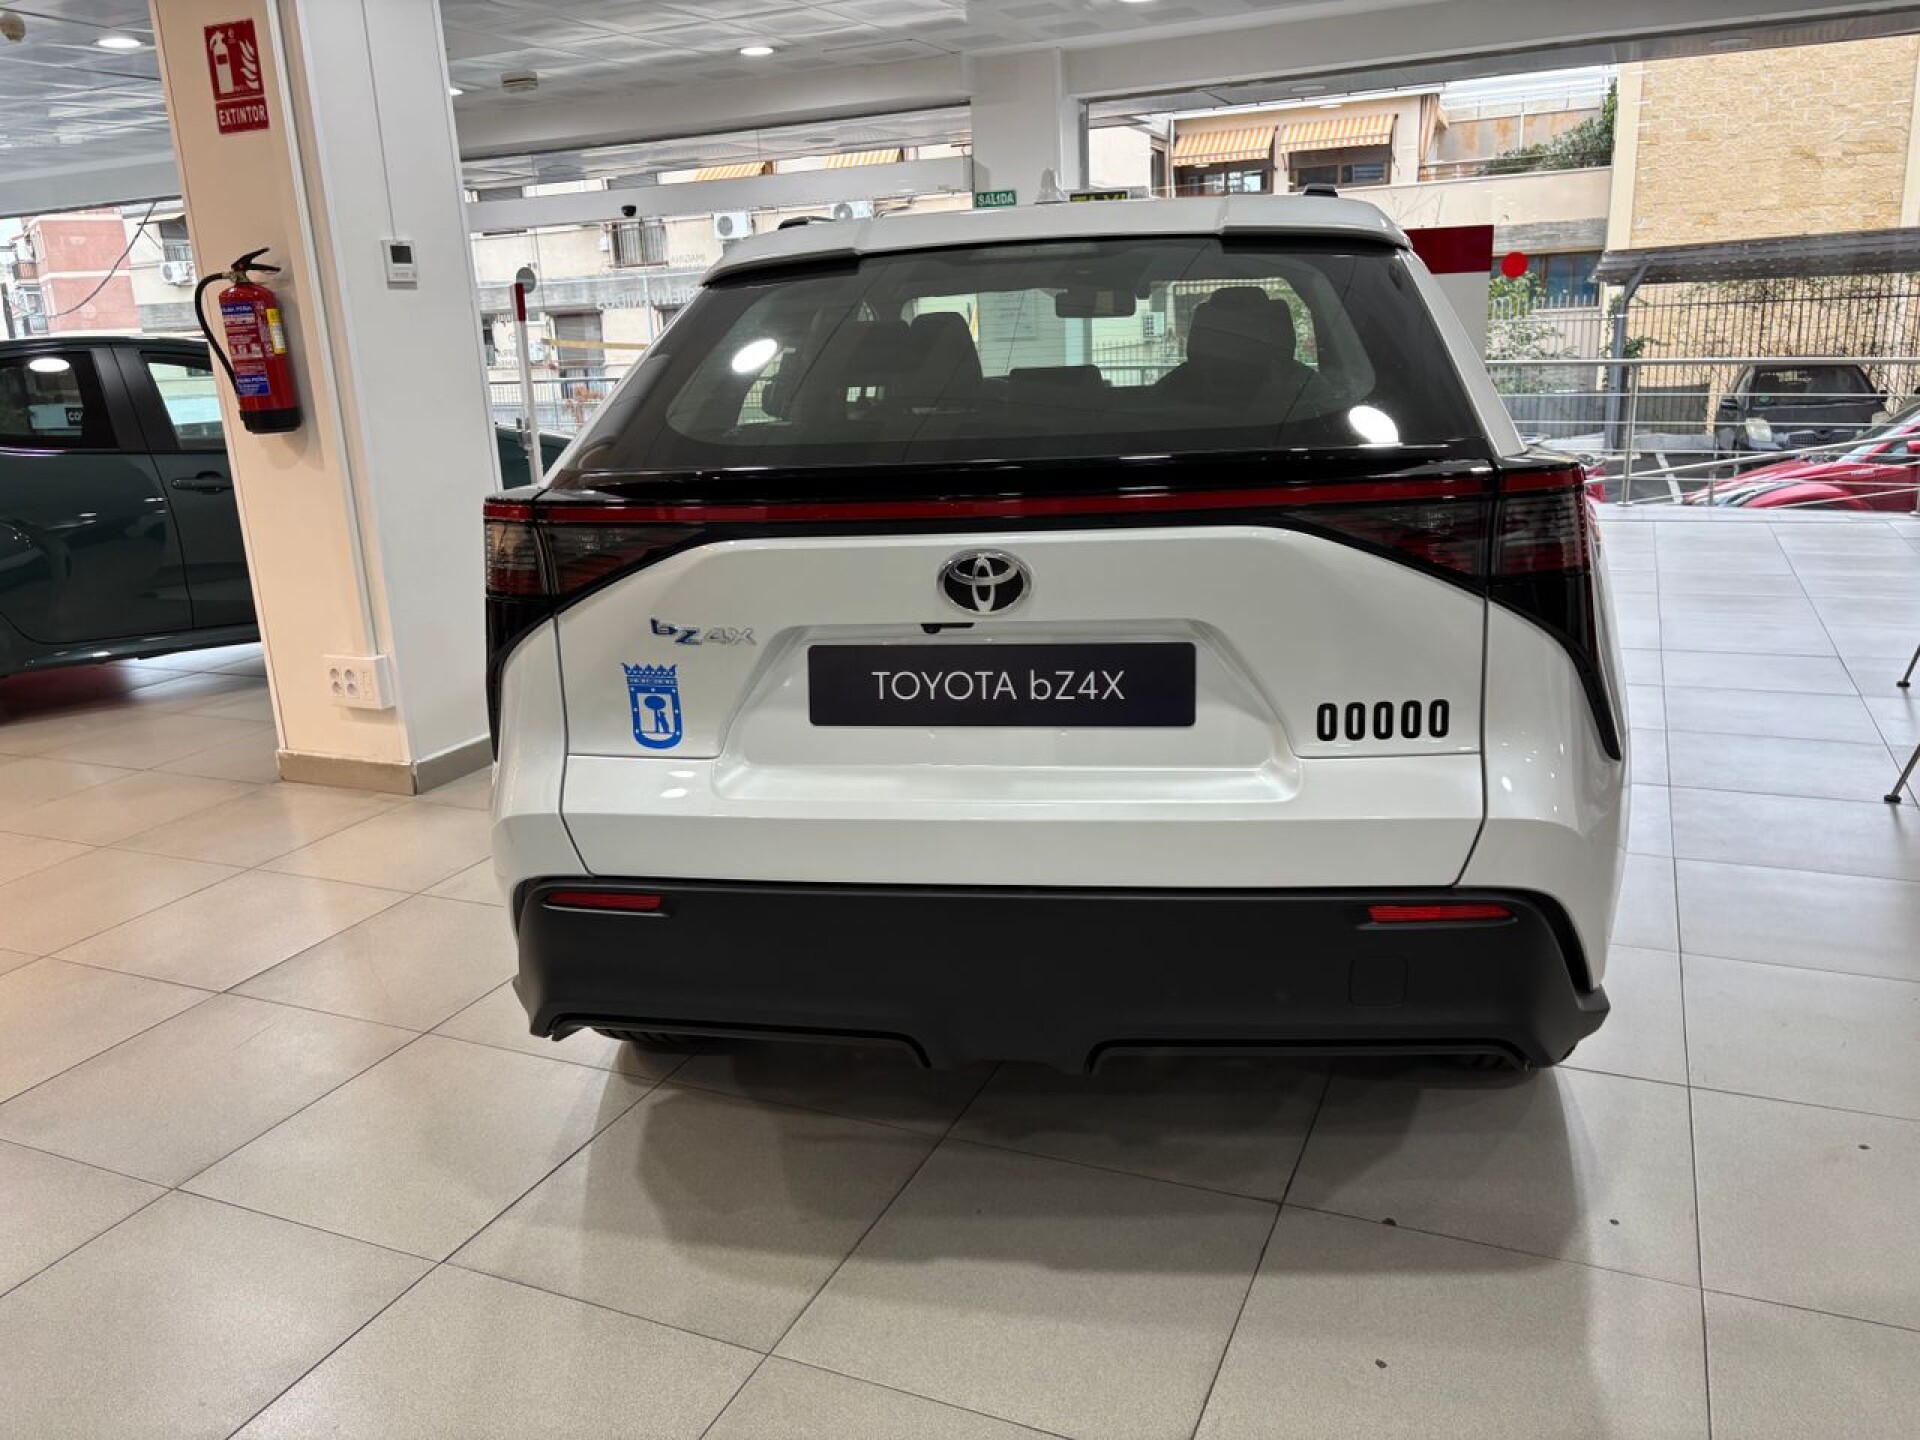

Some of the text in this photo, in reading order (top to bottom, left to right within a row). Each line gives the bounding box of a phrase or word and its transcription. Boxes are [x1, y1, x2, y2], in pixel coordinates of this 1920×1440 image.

[218, 104, 267, 127] EXTINTOR
[977, 193, 1015, 206] SALIDA
[650, 617, 757, 646] bZ4X
[871, 669, 1126, 700] TOYOTA bZ4X
[1316, 699, 1449, 741] 00000
